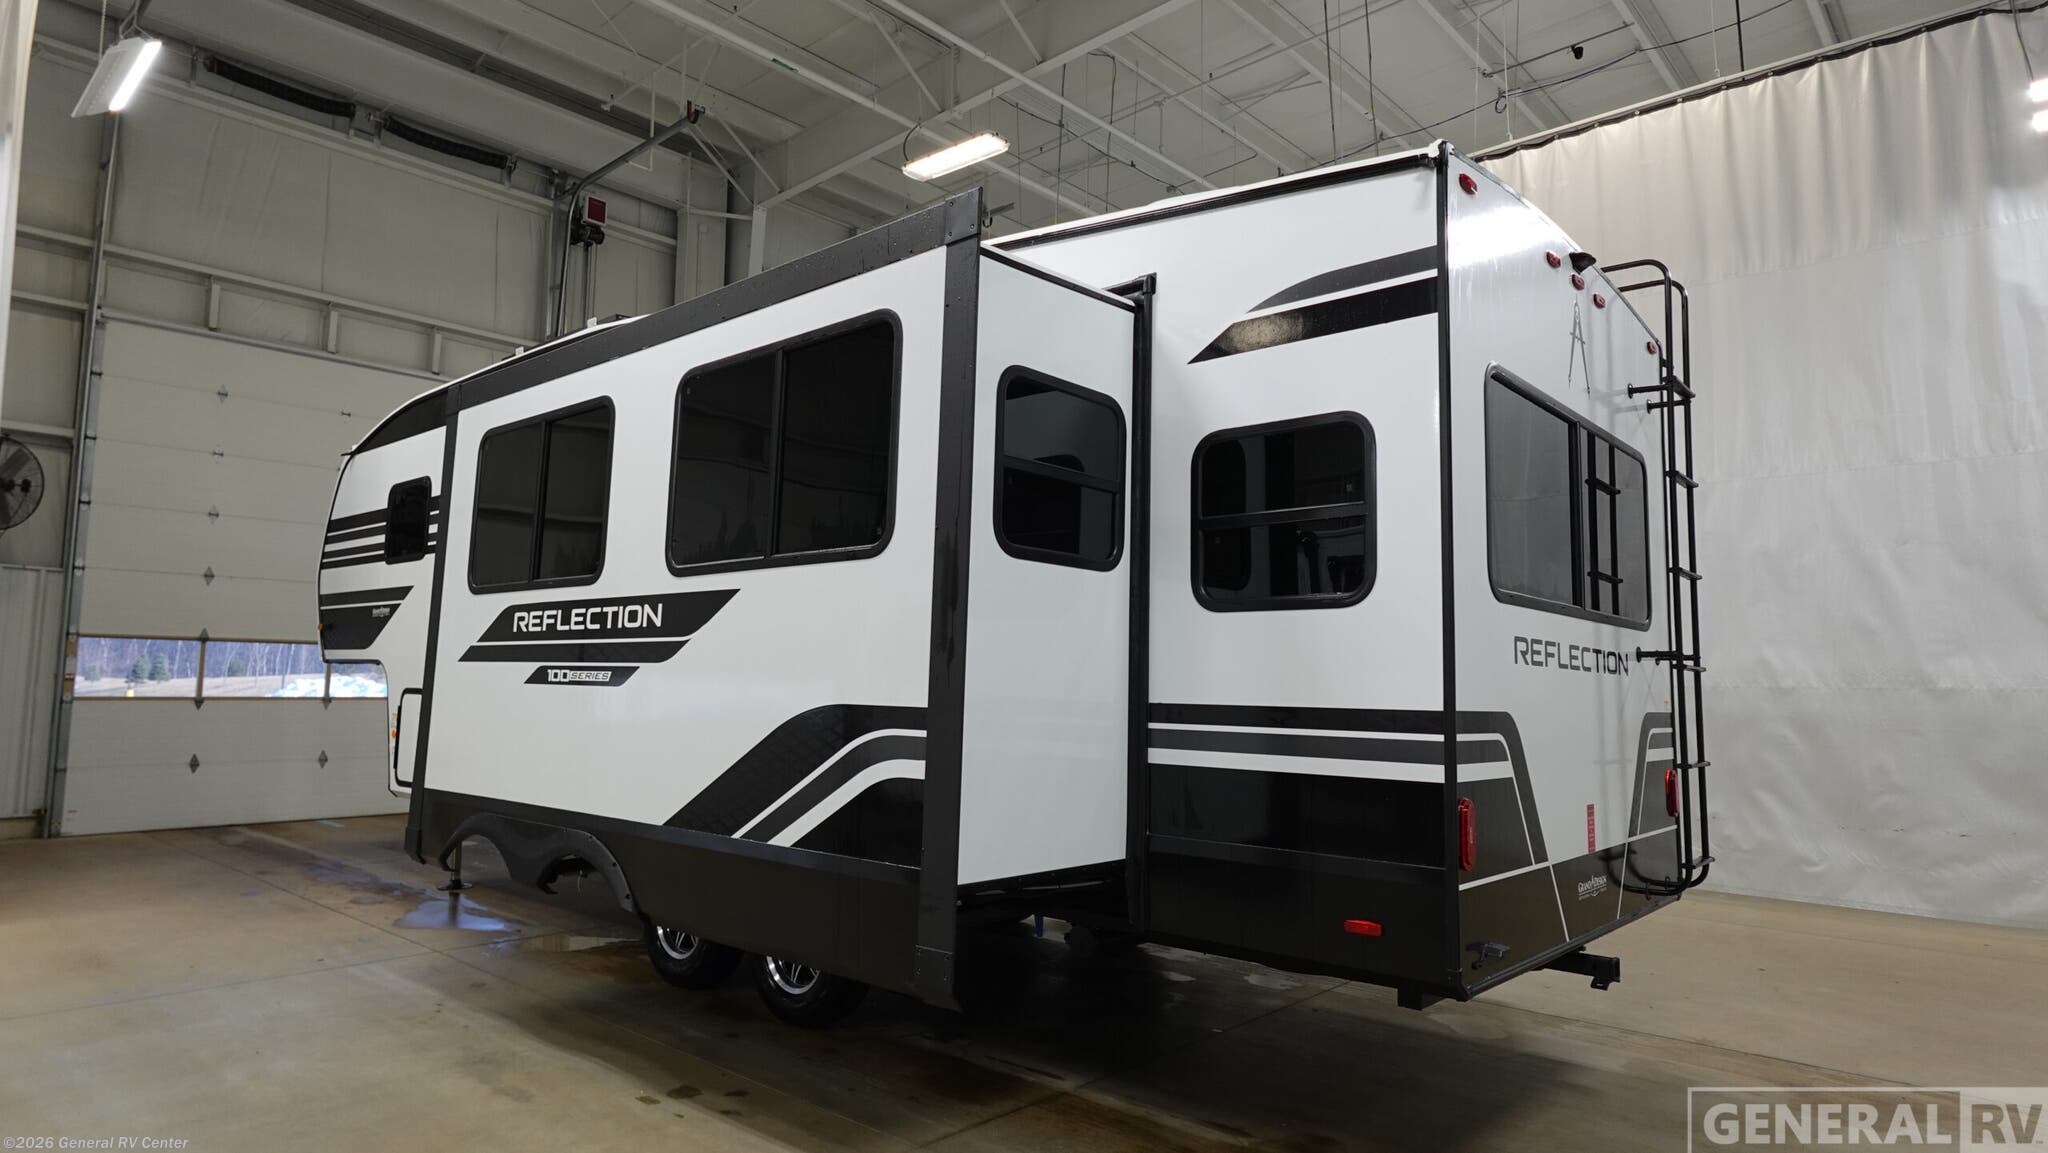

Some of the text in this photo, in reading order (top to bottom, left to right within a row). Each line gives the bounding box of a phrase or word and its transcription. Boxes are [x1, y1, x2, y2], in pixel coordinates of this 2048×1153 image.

[512, 603, 663, 633] REFLECTION
[1513, 635, 1629, 677] REFLECTION
[547, 669, 609, 682] 100 SERIES
